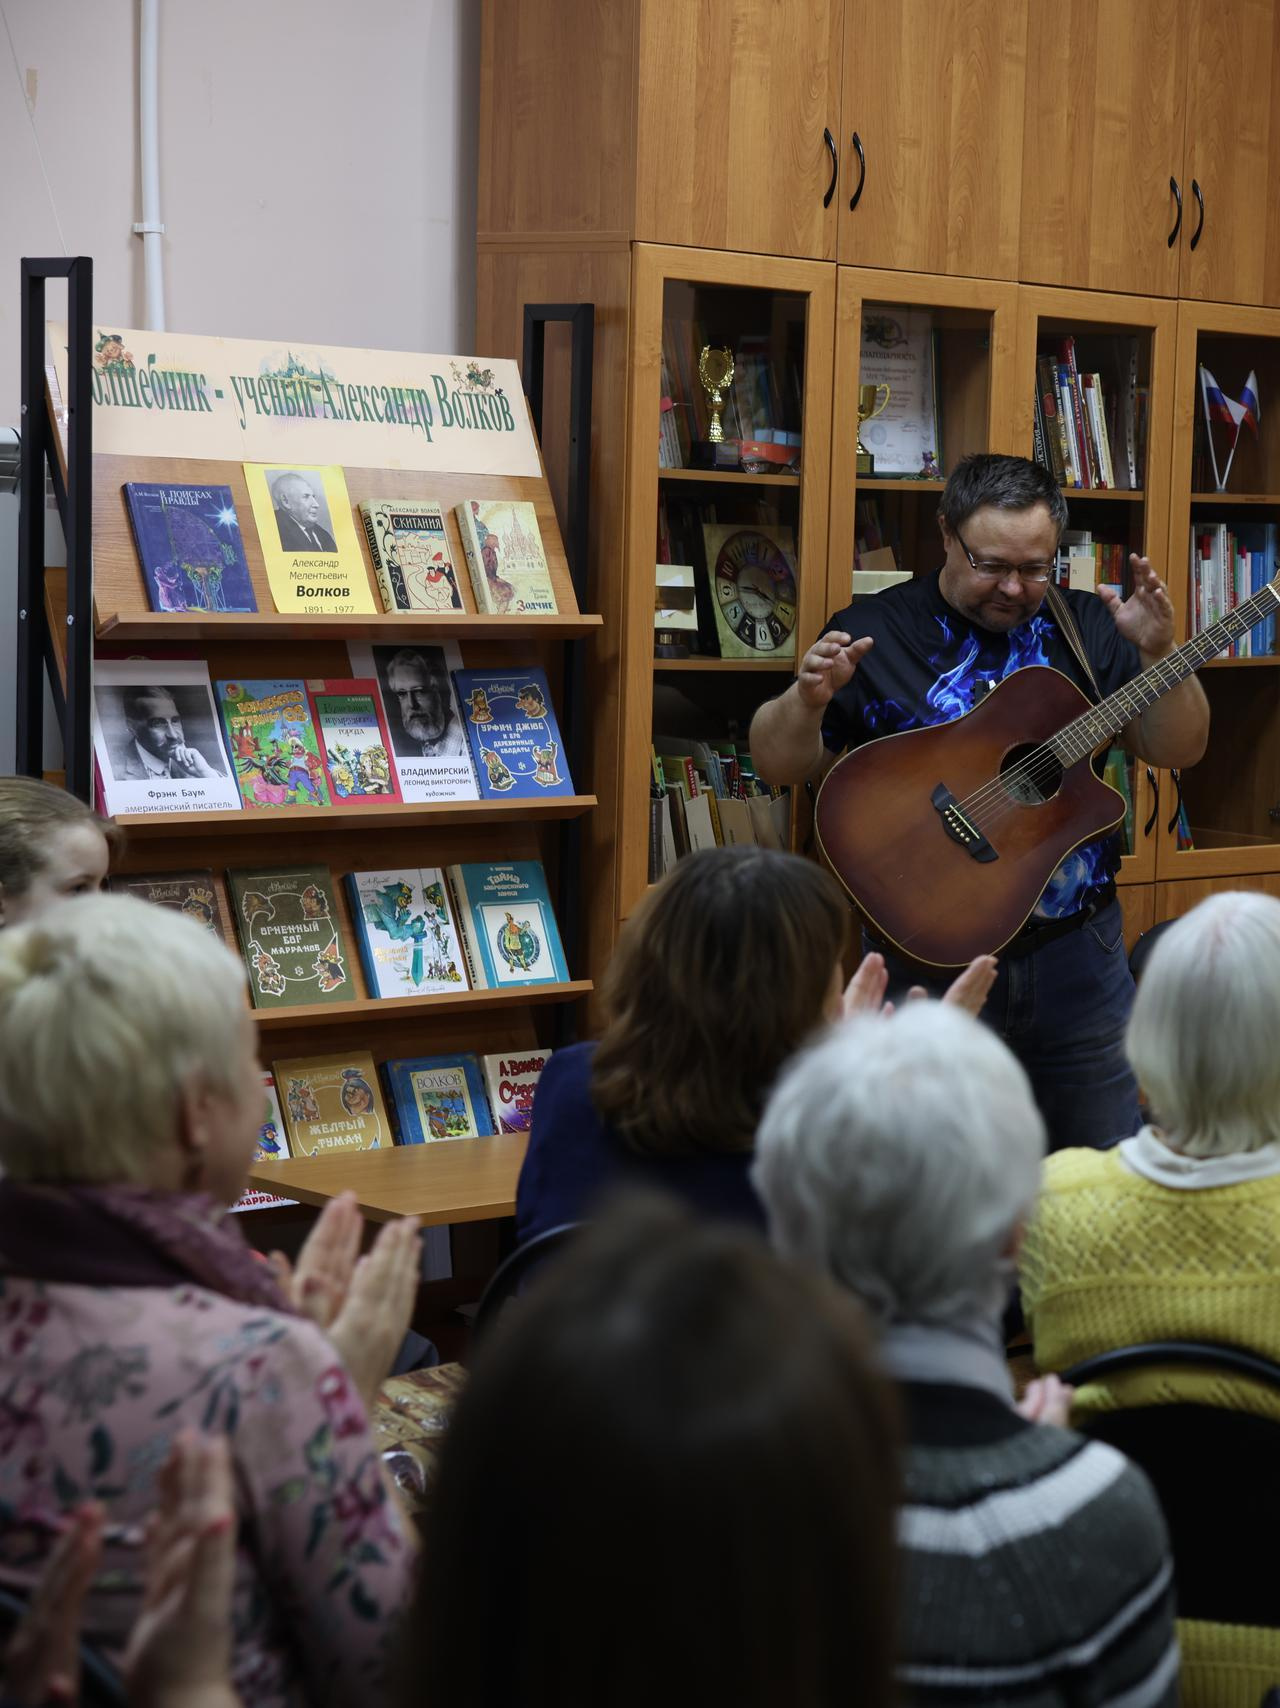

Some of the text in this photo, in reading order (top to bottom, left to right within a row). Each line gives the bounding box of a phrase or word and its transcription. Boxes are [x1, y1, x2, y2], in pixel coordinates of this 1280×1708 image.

[92, 353, 213, 412] олшебник
[320, 368, 433, 442] Александр
[430, 375, 515, 431] Волков
[169, 490, 212, 499] ПОИСКАХ
[393, 518, 441, 529] СКИТАНИЯ
[292, 559, 339, 568] Александр
[289, 571, 348, 580] Мелентьевич
[296, 585, 350, 597] Волков
[334, 605, 354, 613] 1977
[480, 723, 512, 732] УРФИН
[401, 766, 469, 776] ВЛАДИМИРСКИЙ
[148, 789, 205, 799] Фрэнк Баум
[125, 802, 233, 813] американский писатель
[260, 921, 320, 935] ОГНЕННЫЙ
[283, 935, 301, 944] БОГ
[271, 944, 320, 955] МАРРАНОВ
[416, 1073, 462, 1089] ВОЛКОВ
[309, 1116, 366, 1135] ЖЕЛТЫЙ
[318, 1133, 363, 1148] ТУМАН
